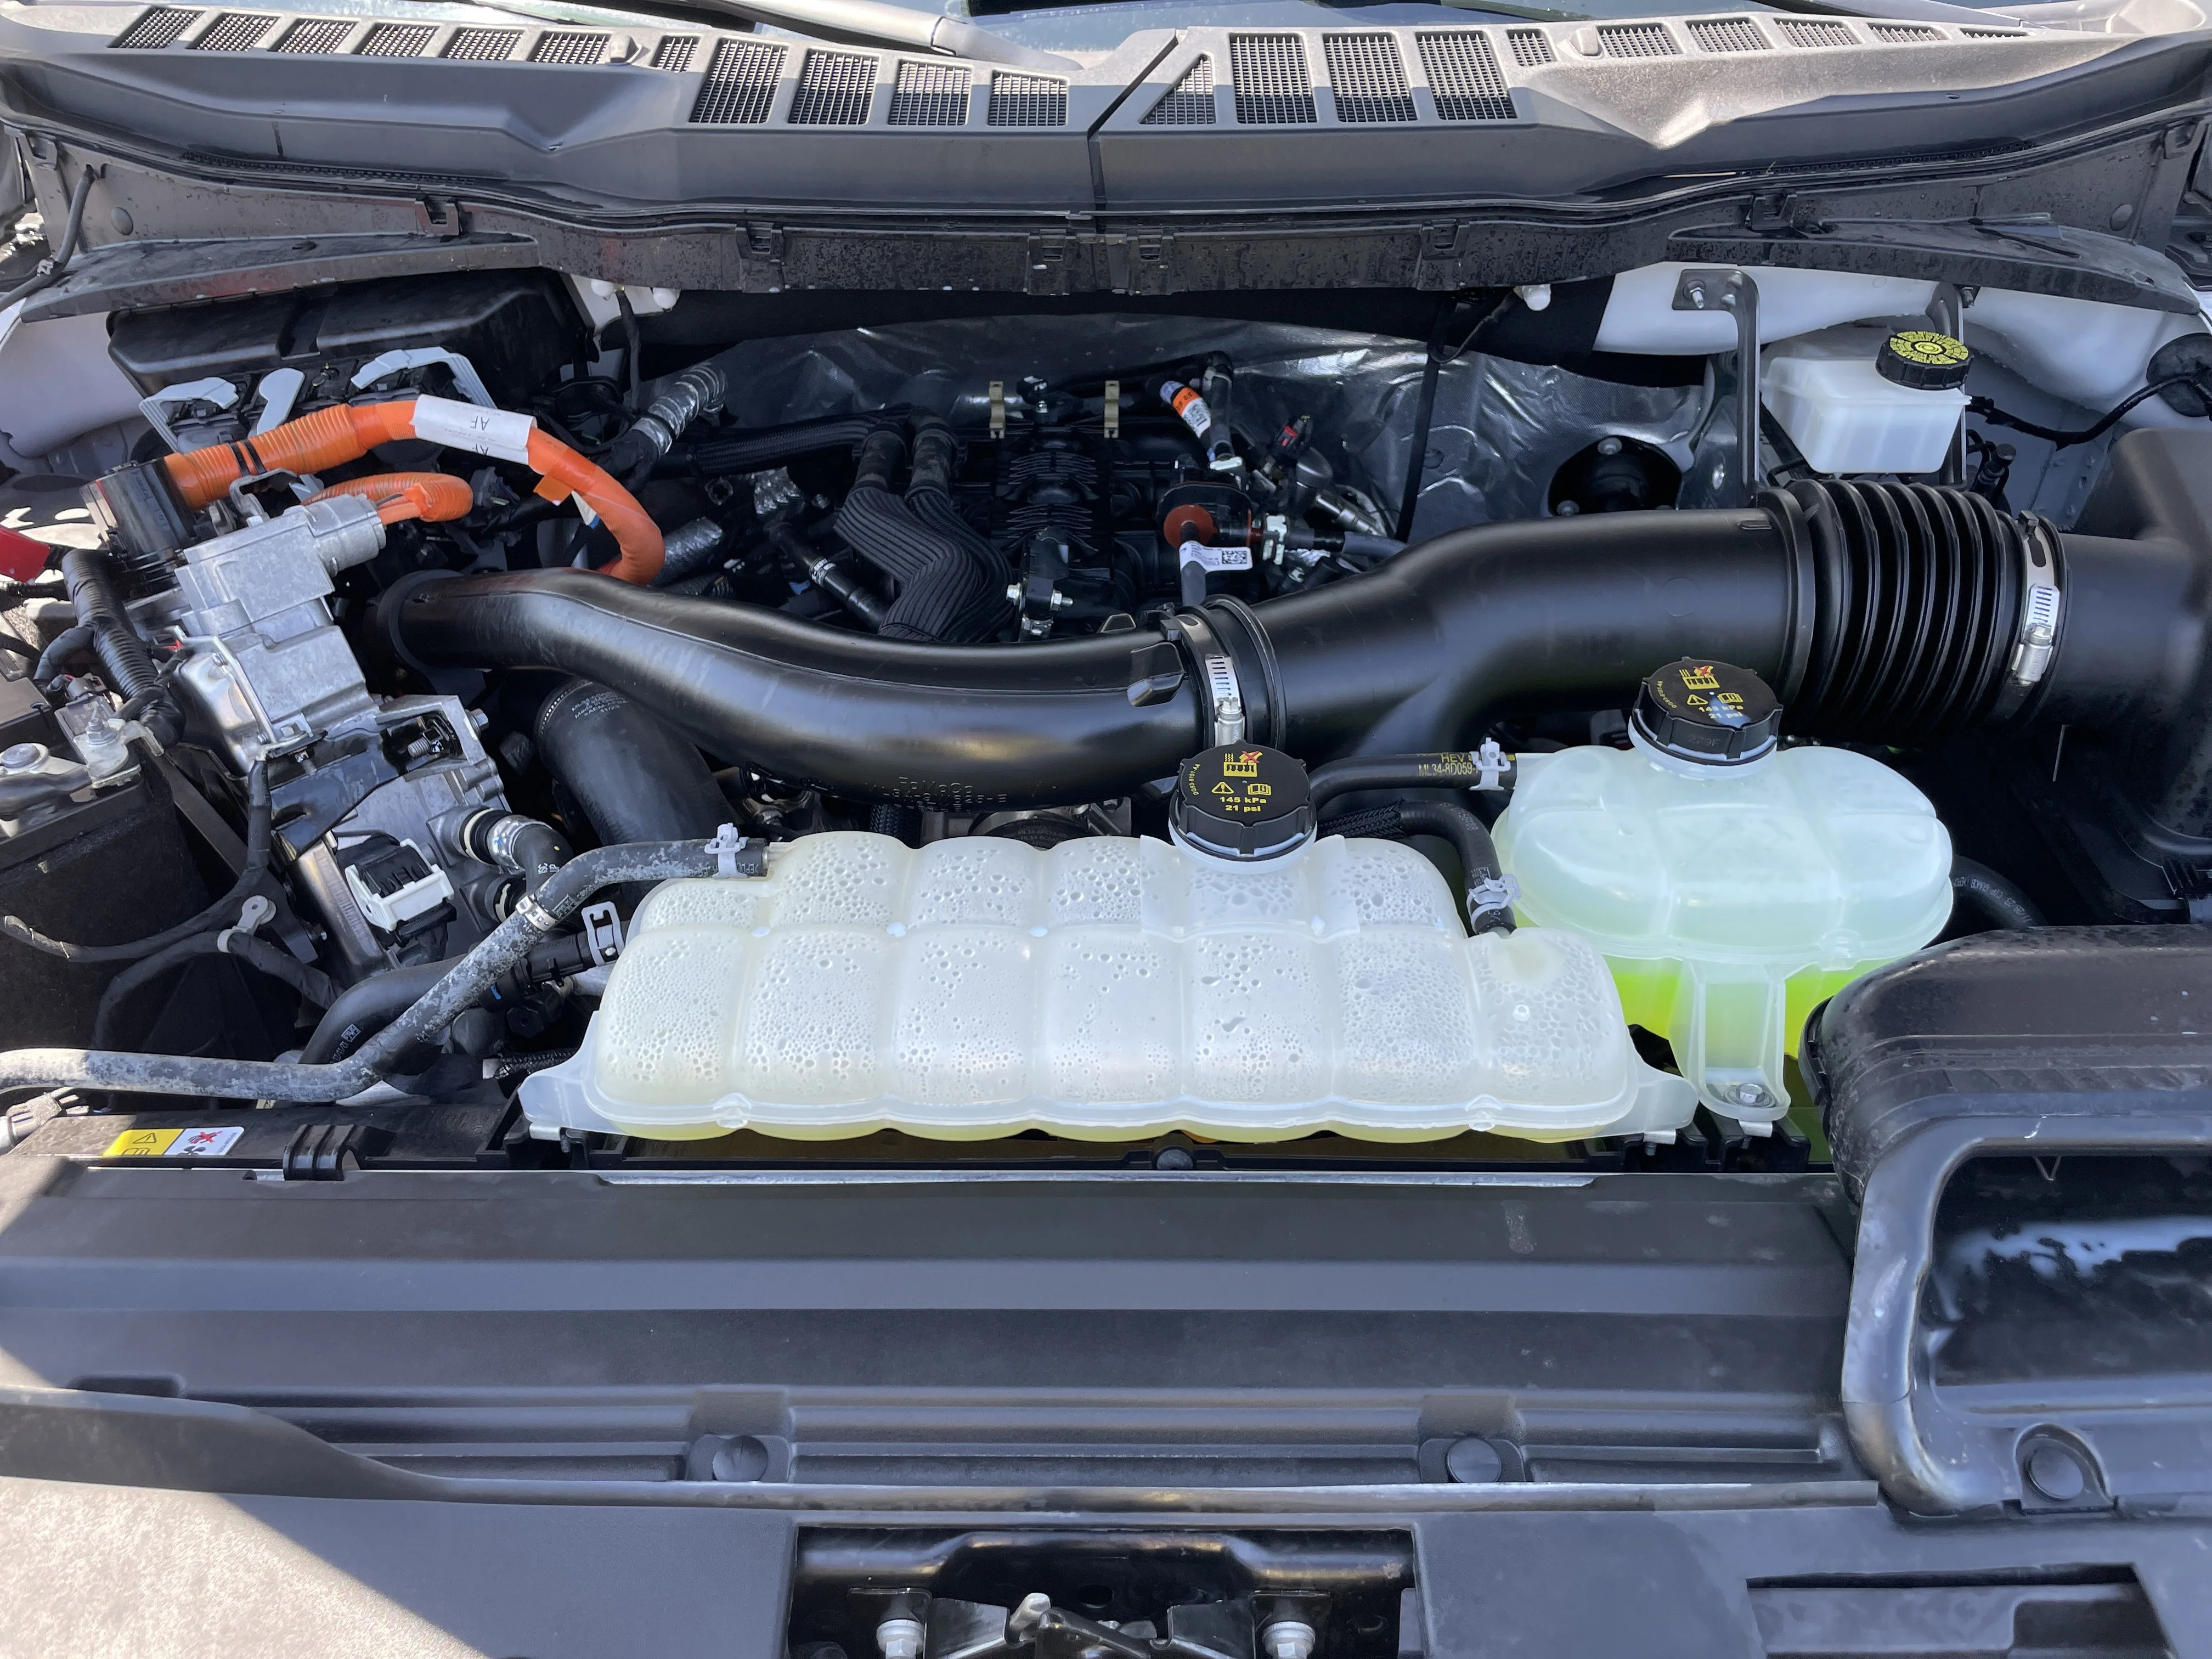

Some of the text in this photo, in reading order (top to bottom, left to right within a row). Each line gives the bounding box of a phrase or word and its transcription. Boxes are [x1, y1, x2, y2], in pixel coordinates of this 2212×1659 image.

[470, 415, 490, 431] AF
[1441, 754, 1465, 763] HEV
[1419, 761, 1480, 777] ML34-8D059-
[899, 776, 973, 794] FoMoCo
